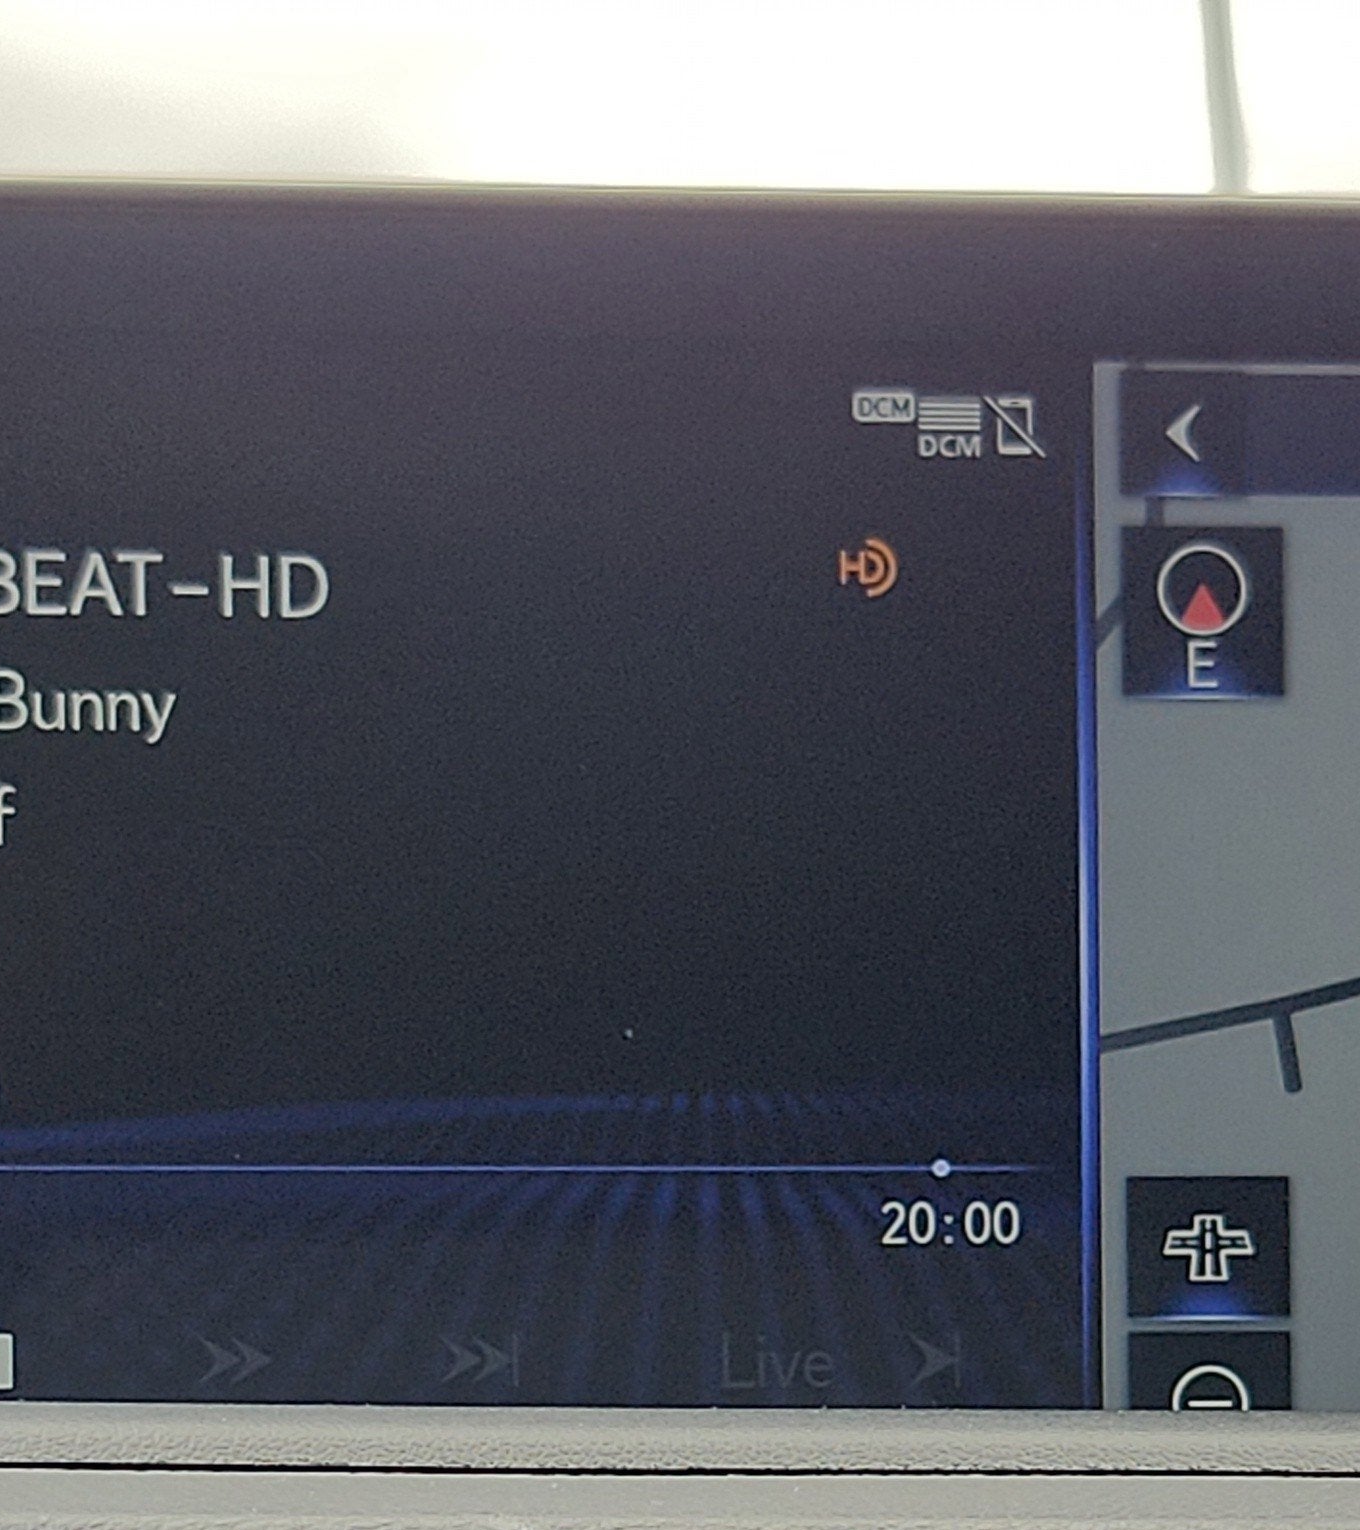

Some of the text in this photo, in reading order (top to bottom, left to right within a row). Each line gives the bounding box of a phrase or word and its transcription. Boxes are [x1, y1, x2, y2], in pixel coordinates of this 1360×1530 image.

[857, 398, 912, 418] DCM
[917, 434, 982, 458] DCM
[1185, 640, 1220, 690] E
[880, 1200, 1022, 1248] 20:00
[720, 1335, 835, 1390] Live
